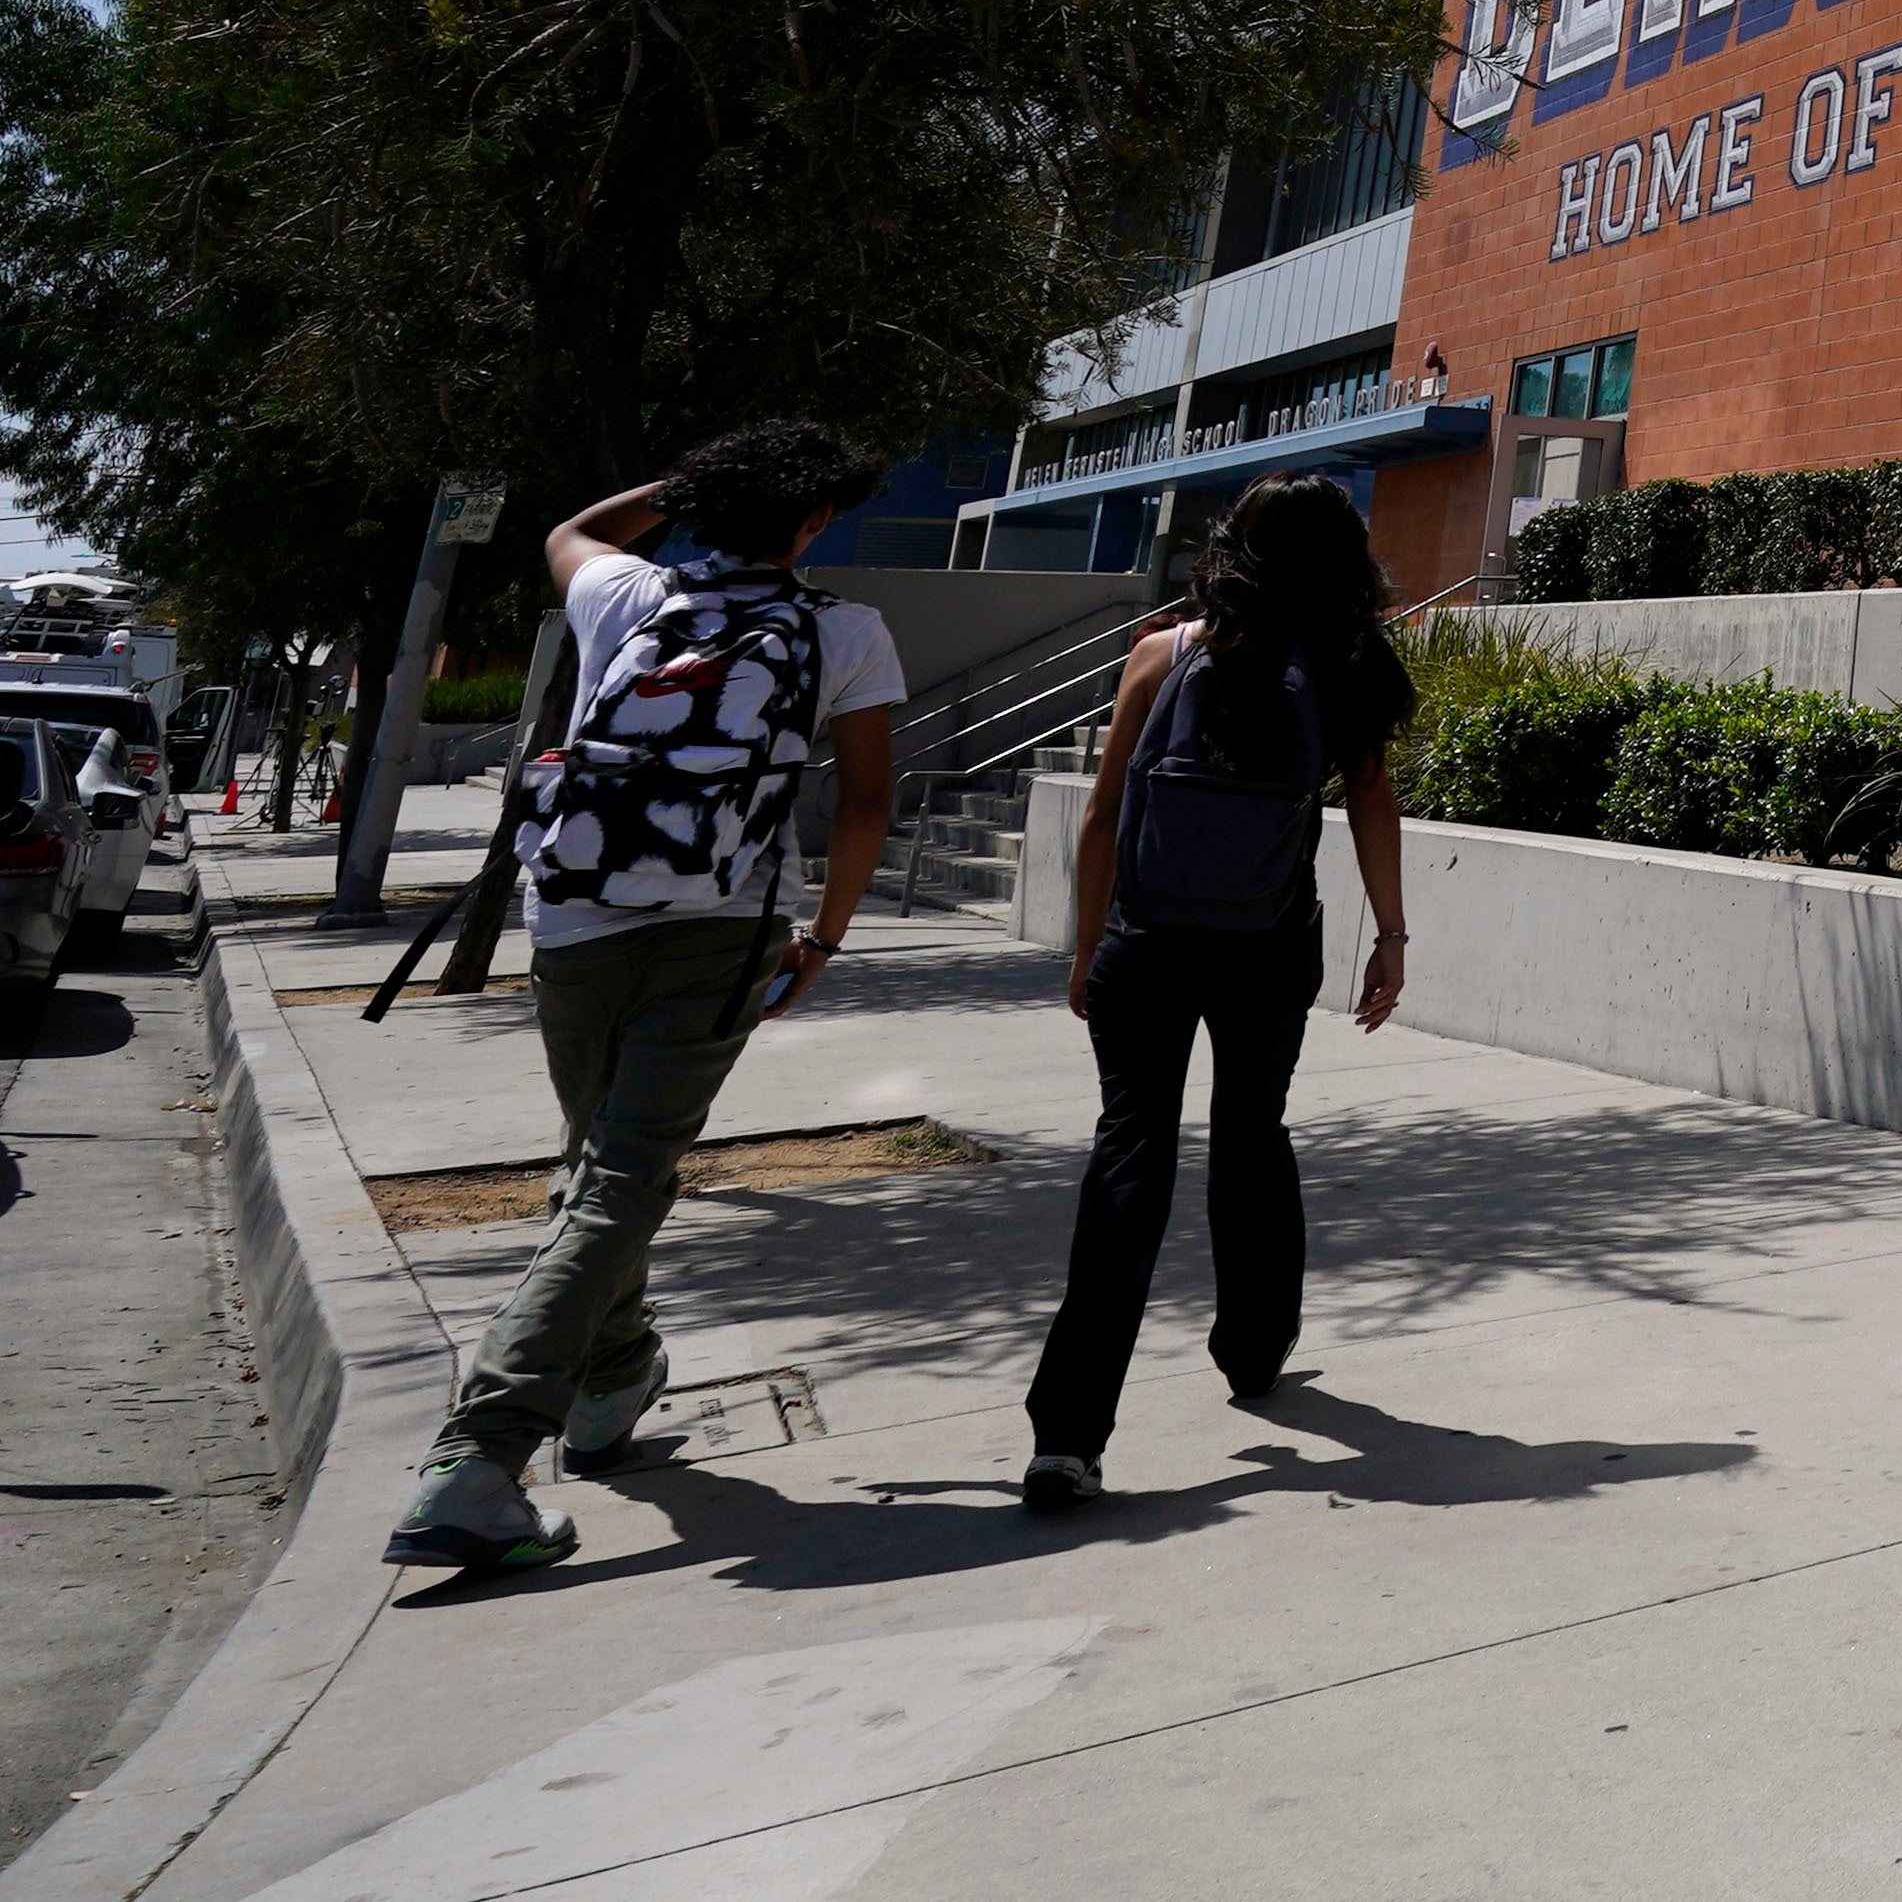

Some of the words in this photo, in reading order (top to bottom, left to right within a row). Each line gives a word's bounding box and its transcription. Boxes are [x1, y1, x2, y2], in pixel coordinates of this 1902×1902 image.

[1548, 96, 1764, 263] HOME
[1023, 461, 1060, 490] HELEN
[1062, 444, 1138, 483] BERNSTEIN
[1139, 433, 1175, 466] HIGH
[1181, 419, 1244, 457] SCHOOL
[1267, 394, 1343, 439] DRAGON
[1354, 375, 1417, 419] PRIDE
